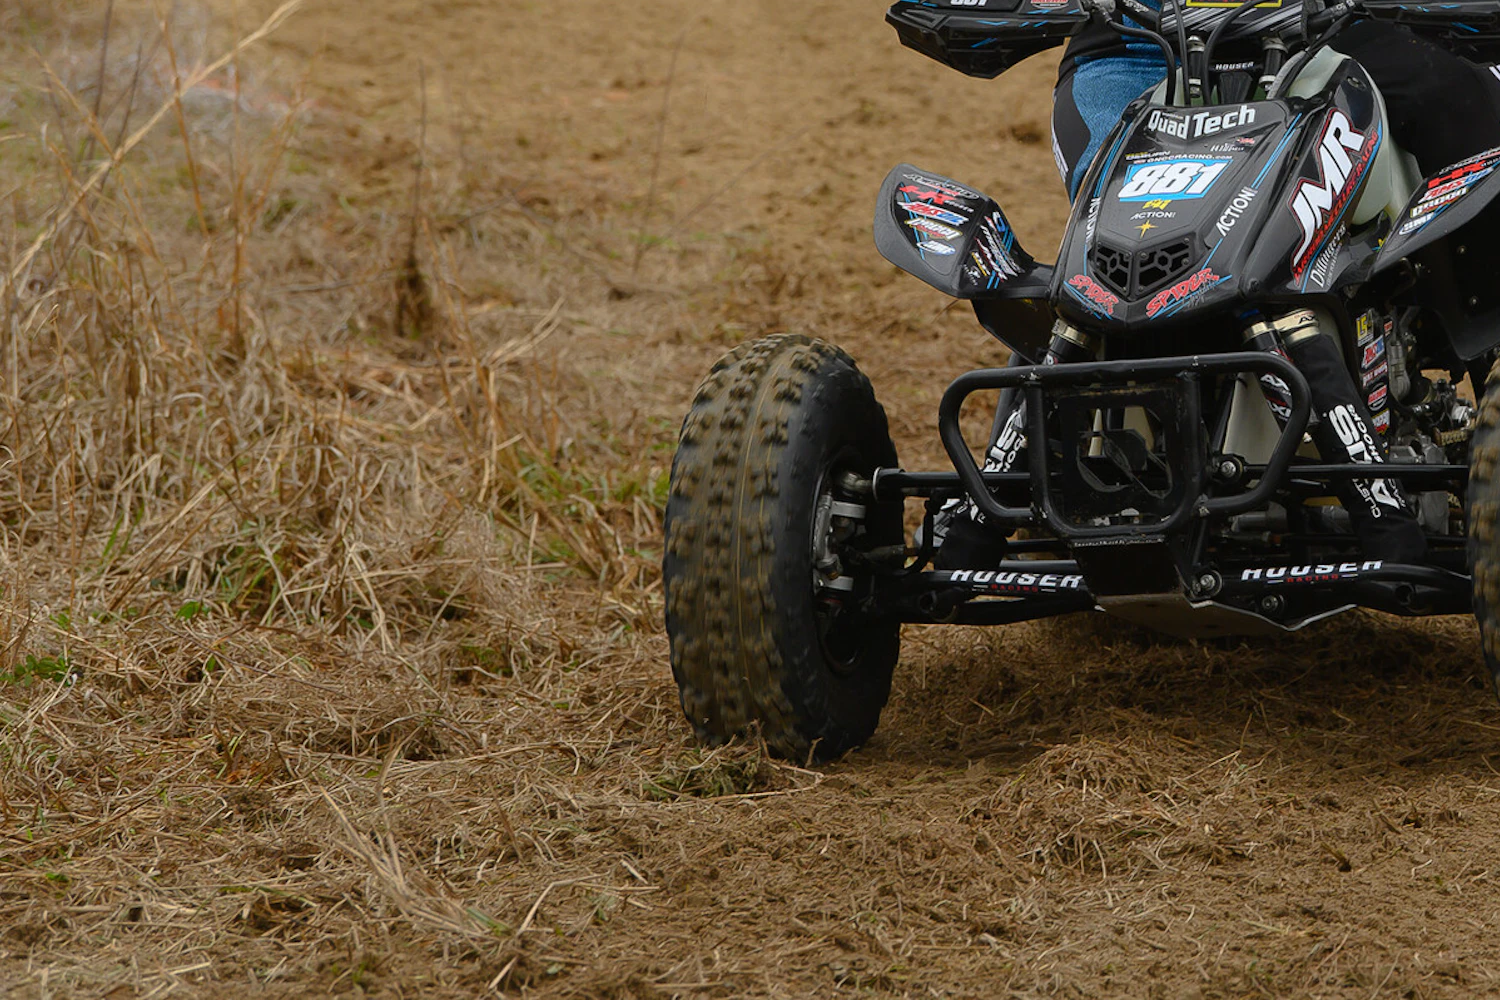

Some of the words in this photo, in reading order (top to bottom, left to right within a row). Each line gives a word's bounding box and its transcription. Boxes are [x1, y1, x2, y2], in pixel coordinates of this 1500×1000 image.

[1118, 162, 1228, 198] 881
[1292, 111, 1366, 267] JMR
[1130, 211, 1177, 221] ACTION!
[1215, 185, 1259, 237] ACTION!
[1146, 268, 1214, 317] SPIDER
